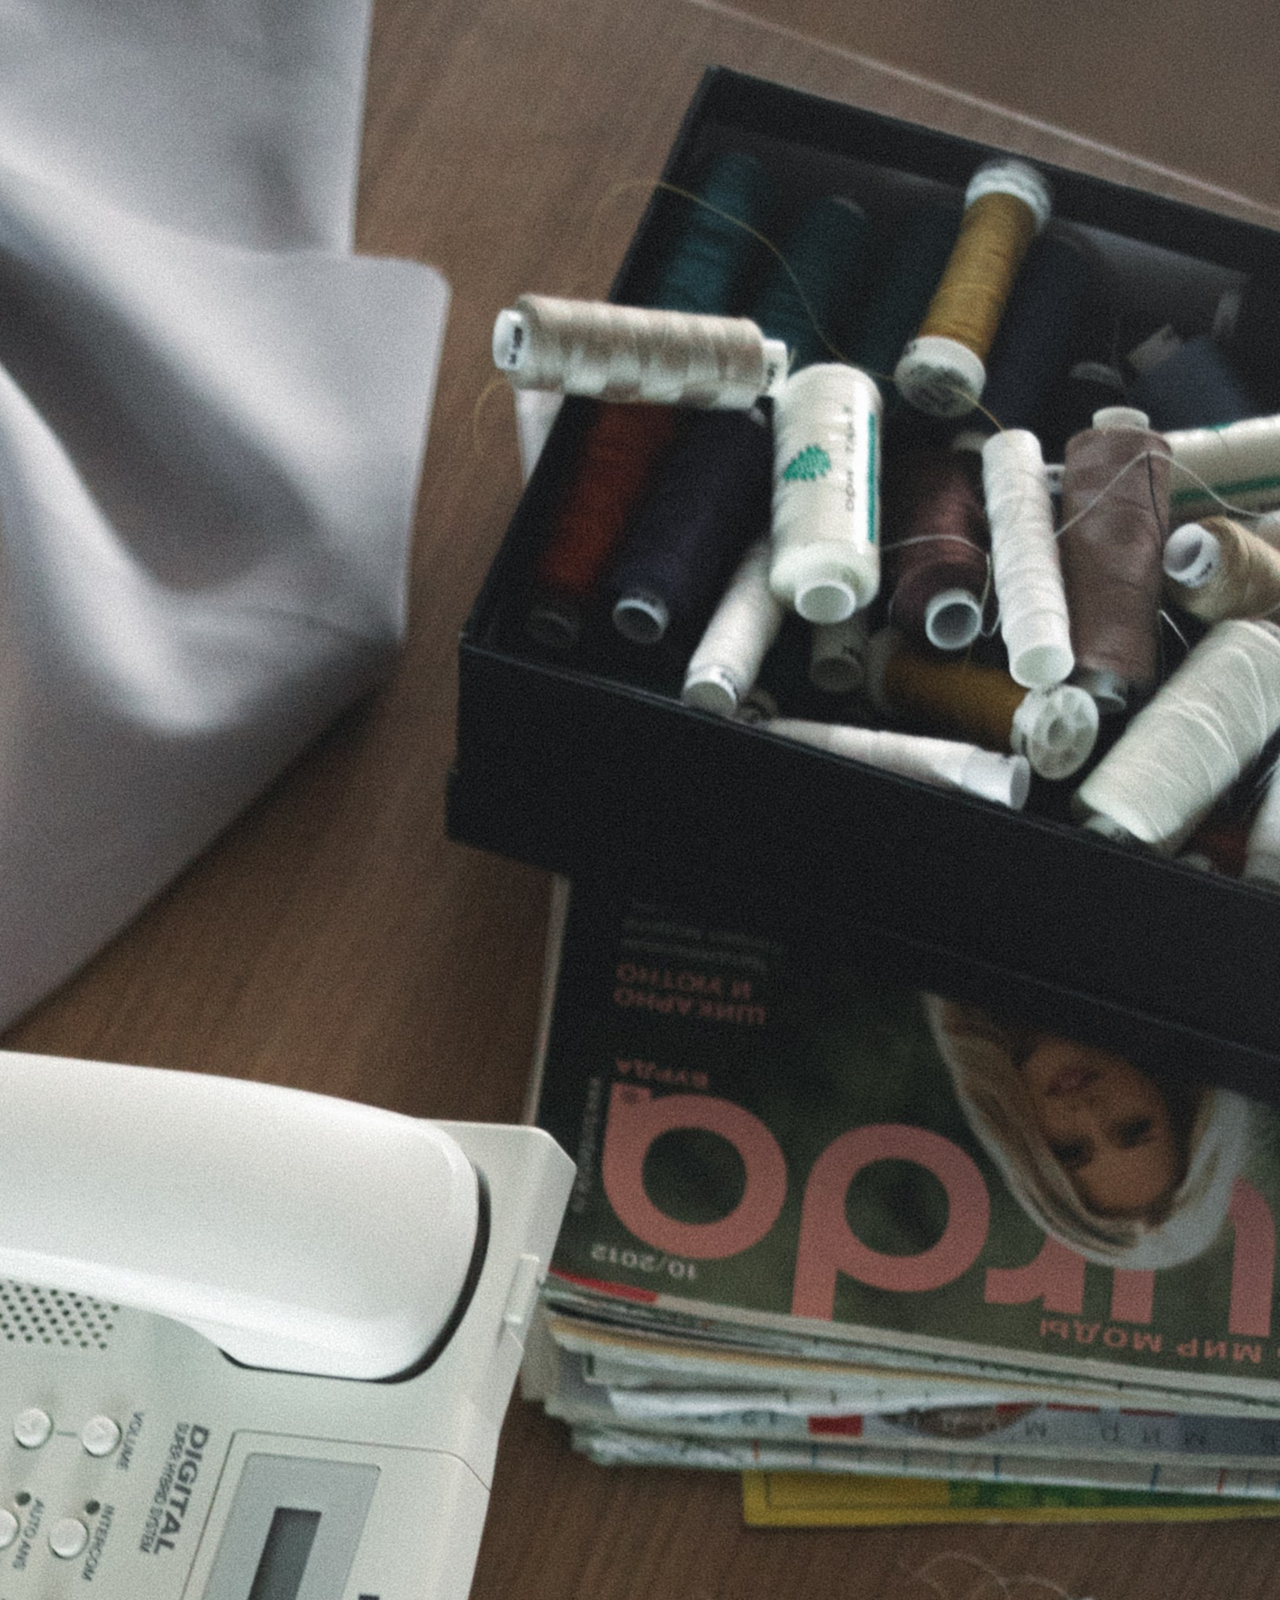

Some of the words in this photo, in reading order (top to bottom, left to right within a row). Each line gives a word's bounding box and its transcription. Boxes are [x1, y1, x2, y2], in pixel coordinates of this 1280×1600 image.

[616, 963, 724, 994] УЮТНО
[613, 988, 768, 1026] ШИКАРНО
[590, 1243, 699, 1281] 10/2012
[1040, 1319, 1163, 1353] МОДЫ
[1175, 1337, 1261, 1363] МИР
[114, 1409, 144, 1472] VOLUME
[165, 1421, 189, 1463] SUPER
[153, 1461, 177, 1505] HYBRID
[154, 1423, 210, 1556] DIGITAL
[22, 1498, 45, 1540] AUTO
[137, 1505, 163, 1553] SYSTEM
[11, 1538, 32, 1571] ANS
[79, 1502, 114, 1582] INTERCOM
